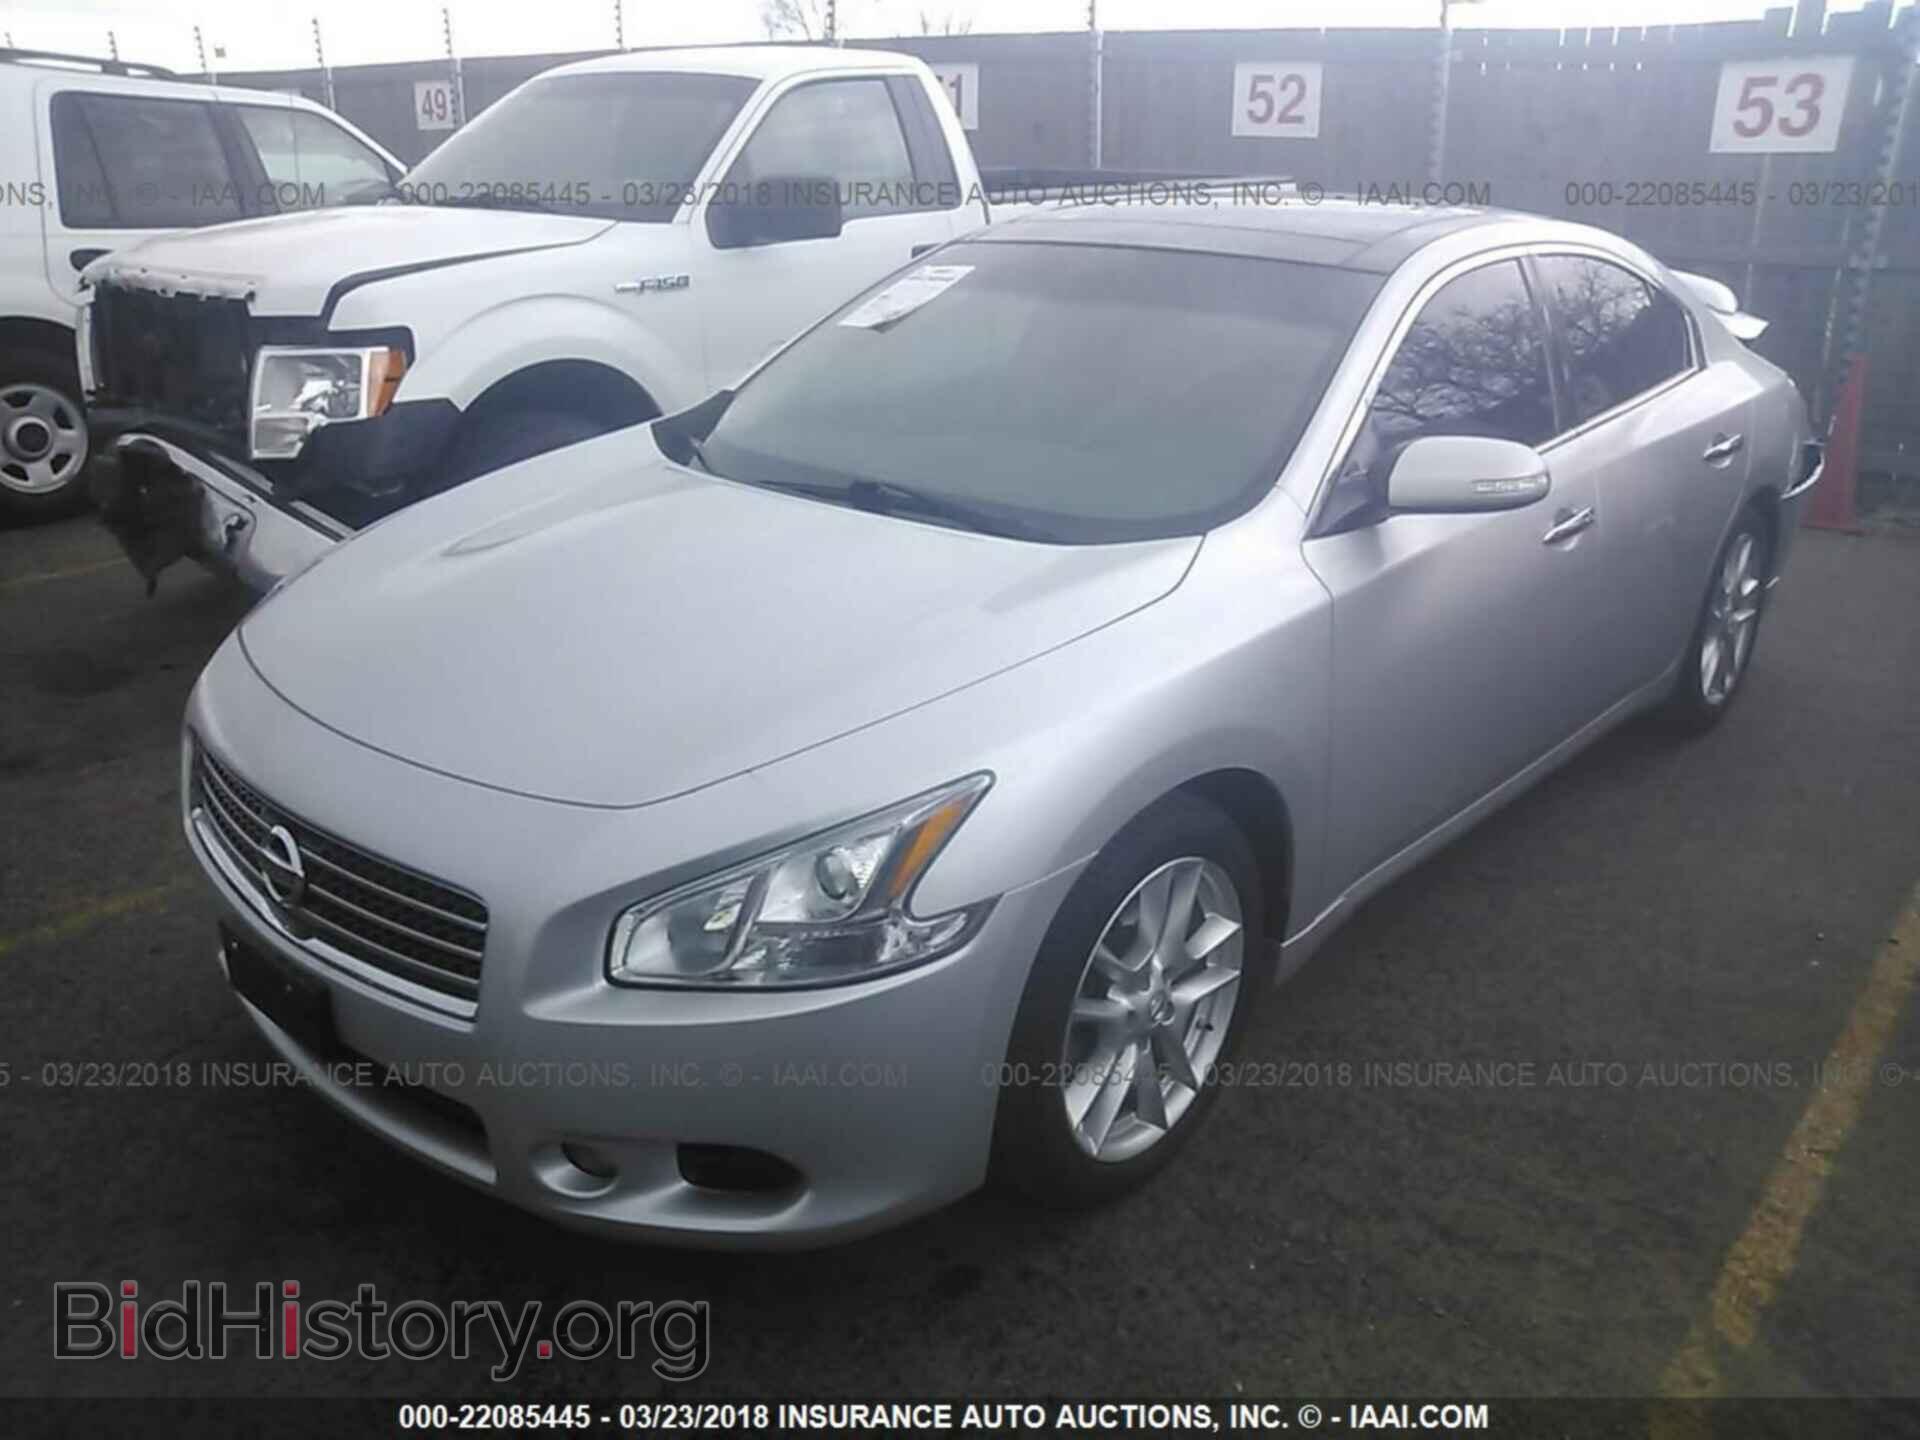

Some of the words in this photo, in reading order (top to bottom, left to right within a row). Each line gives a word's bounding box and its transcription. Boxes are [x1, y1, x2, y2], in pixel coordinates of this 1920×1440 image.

[422, 88, 448, 121] 49
[936, 74, 963, 118] 1
[1247, 74, 1306, 124] 52
[1733, 73, 1824, 138] 53
